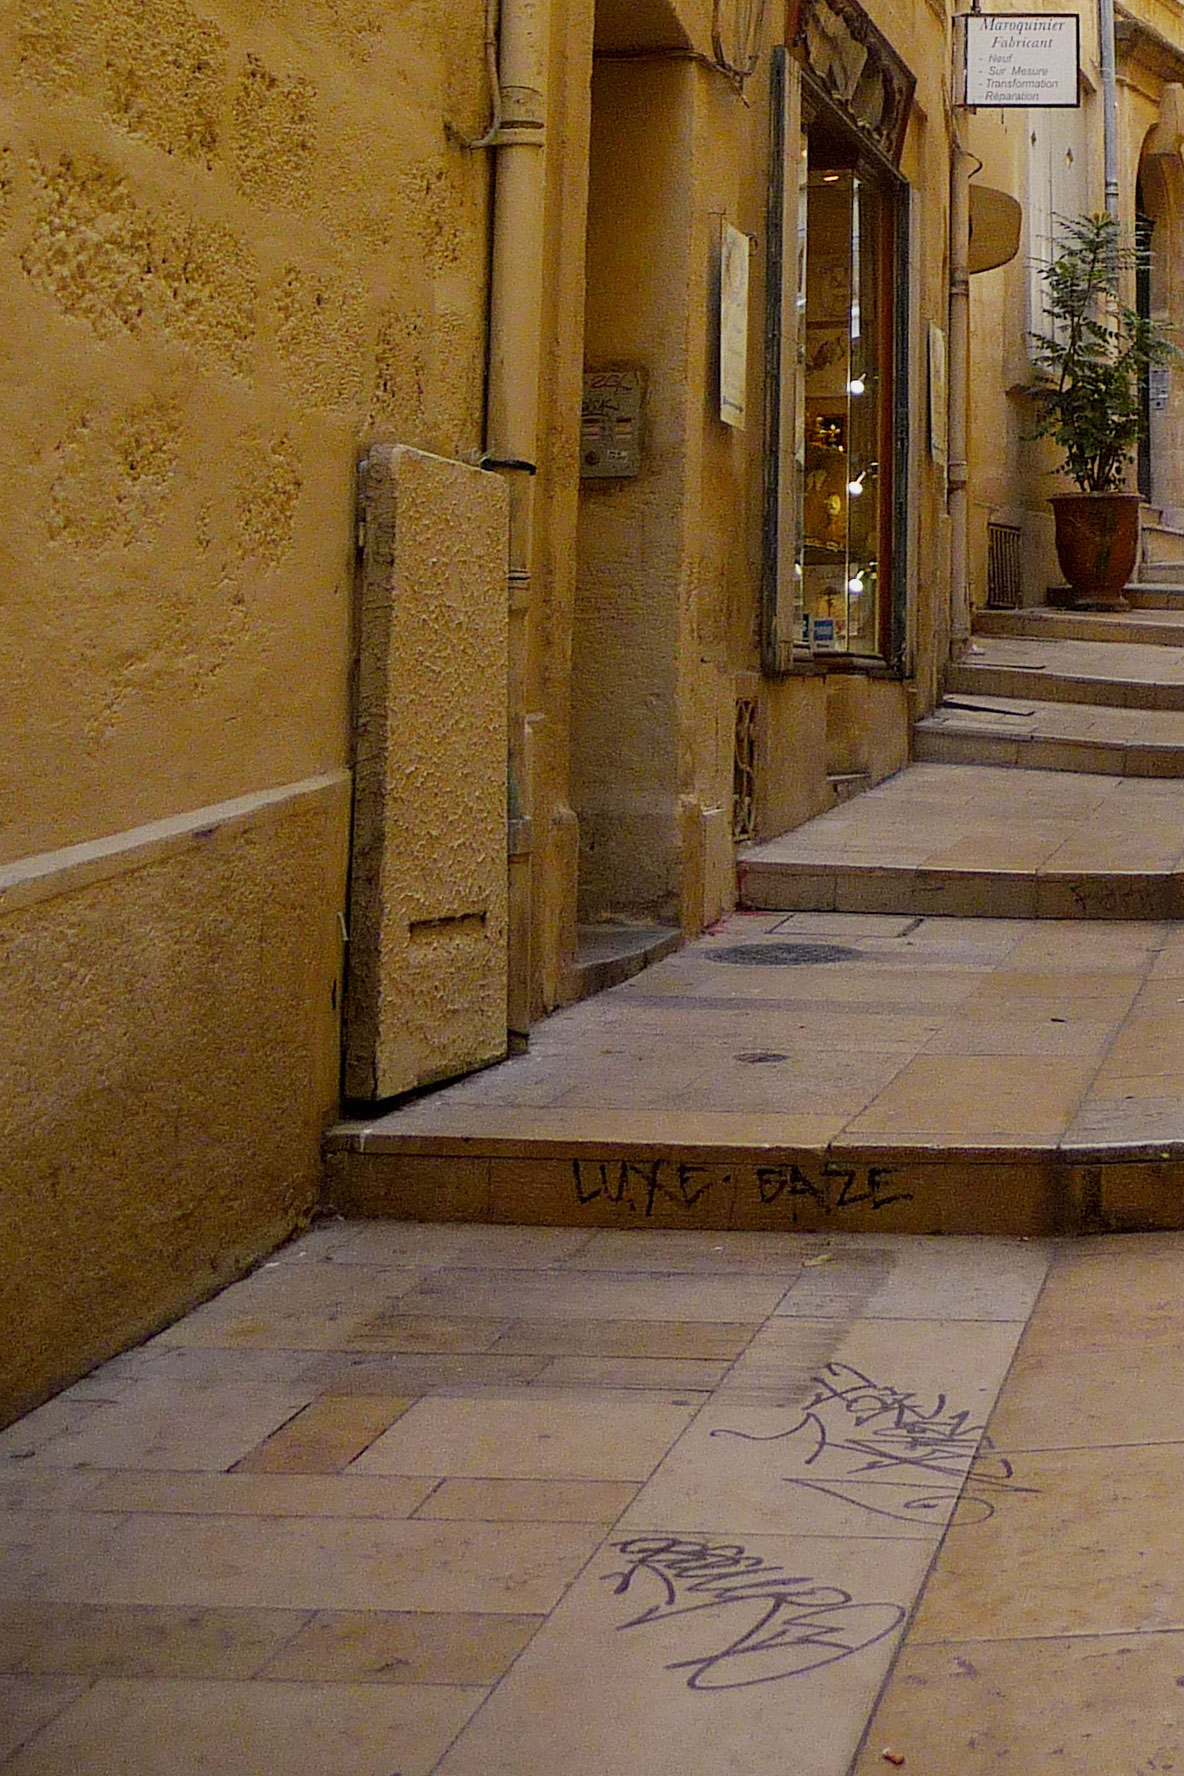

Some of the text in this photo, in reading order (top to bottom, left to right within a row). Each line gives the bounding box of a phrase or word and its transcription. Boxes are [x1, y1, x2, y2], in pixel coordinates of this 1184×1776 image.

[980, 17, 1065, 35] Maroquinier
[991, 36, 1053, 49] Fabricant
[988, 53, 1013, 63] Neuf
[988, 65, 1048, 76] Sur Mesure
[986, 78, 1059, 89] Transformation
[985, 90, 1039, 102] Réparation
